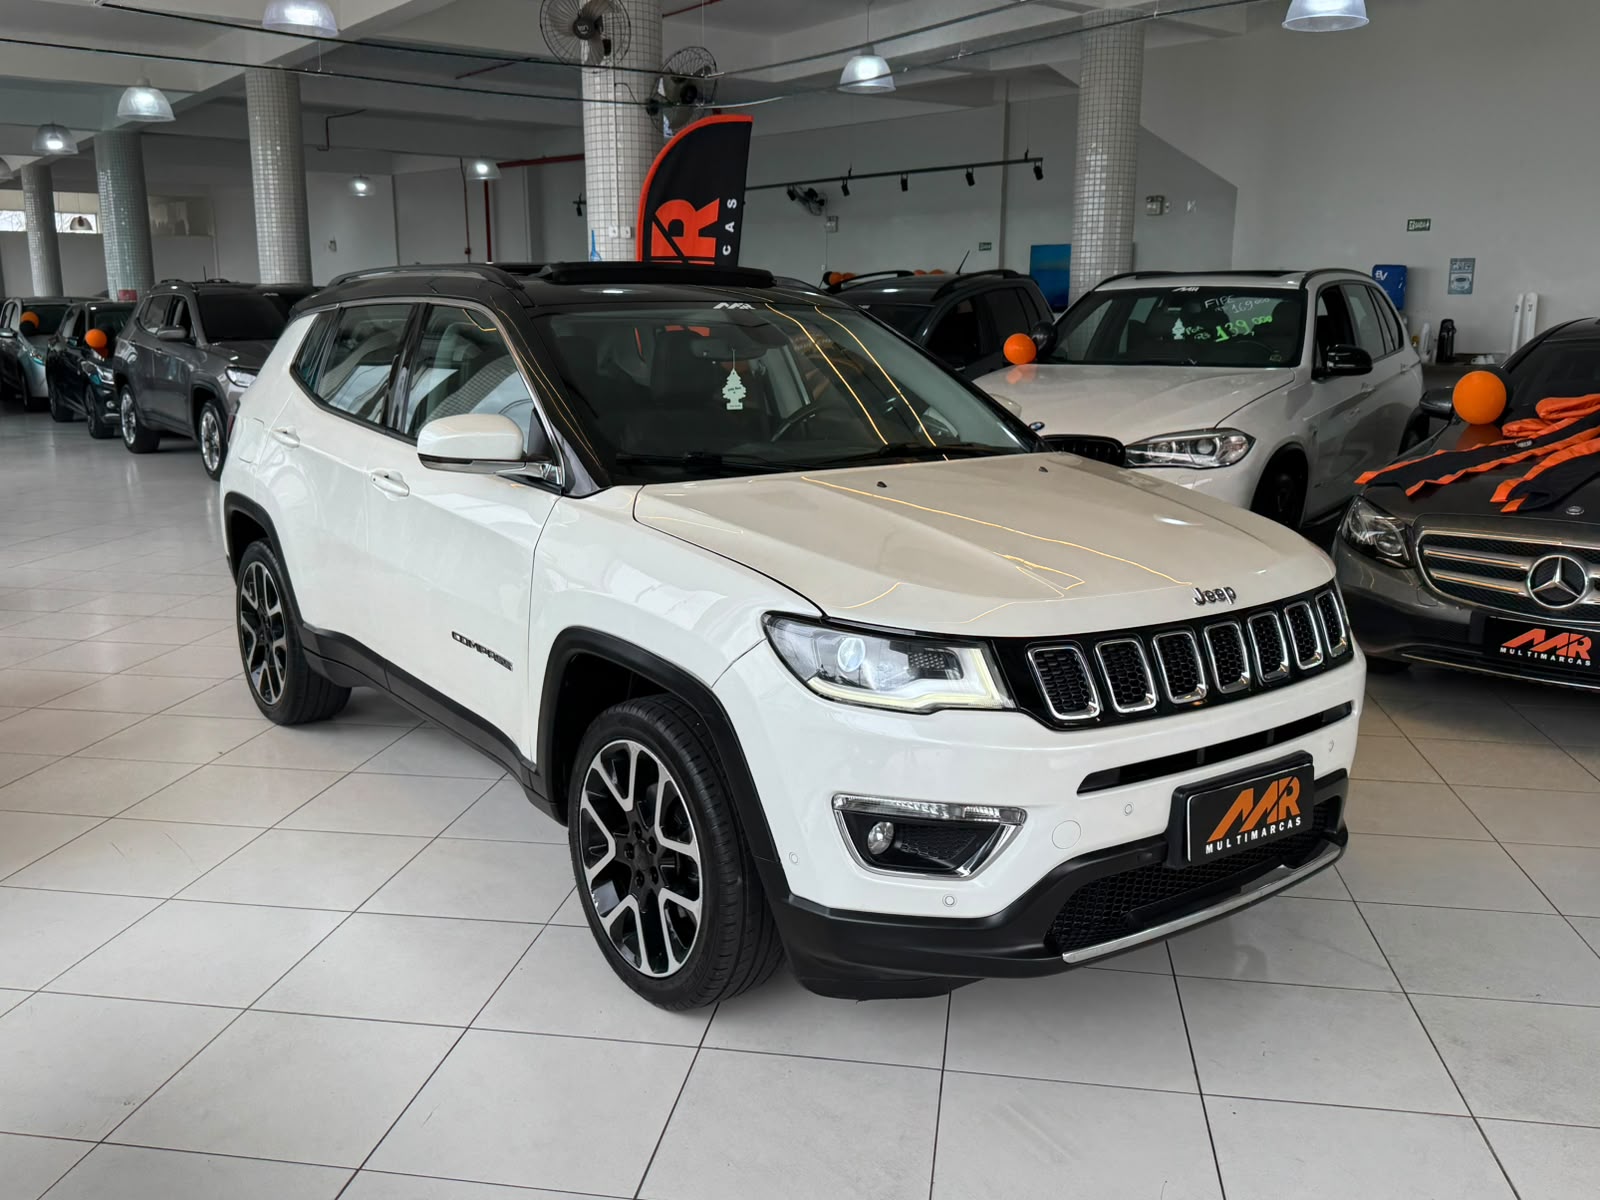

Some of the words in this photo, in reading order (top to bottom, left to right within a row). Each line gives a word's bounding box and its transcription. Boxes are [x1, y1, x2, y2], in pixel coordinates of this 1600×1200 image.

[1204, 295, 1236, 309] FIPE
[1192, 587, 1236, 606] Jeep
[1500, 646, 1591, 666] MULTIMARCAS
[1205, 816, 1302, 855] MULTIMARCAS
